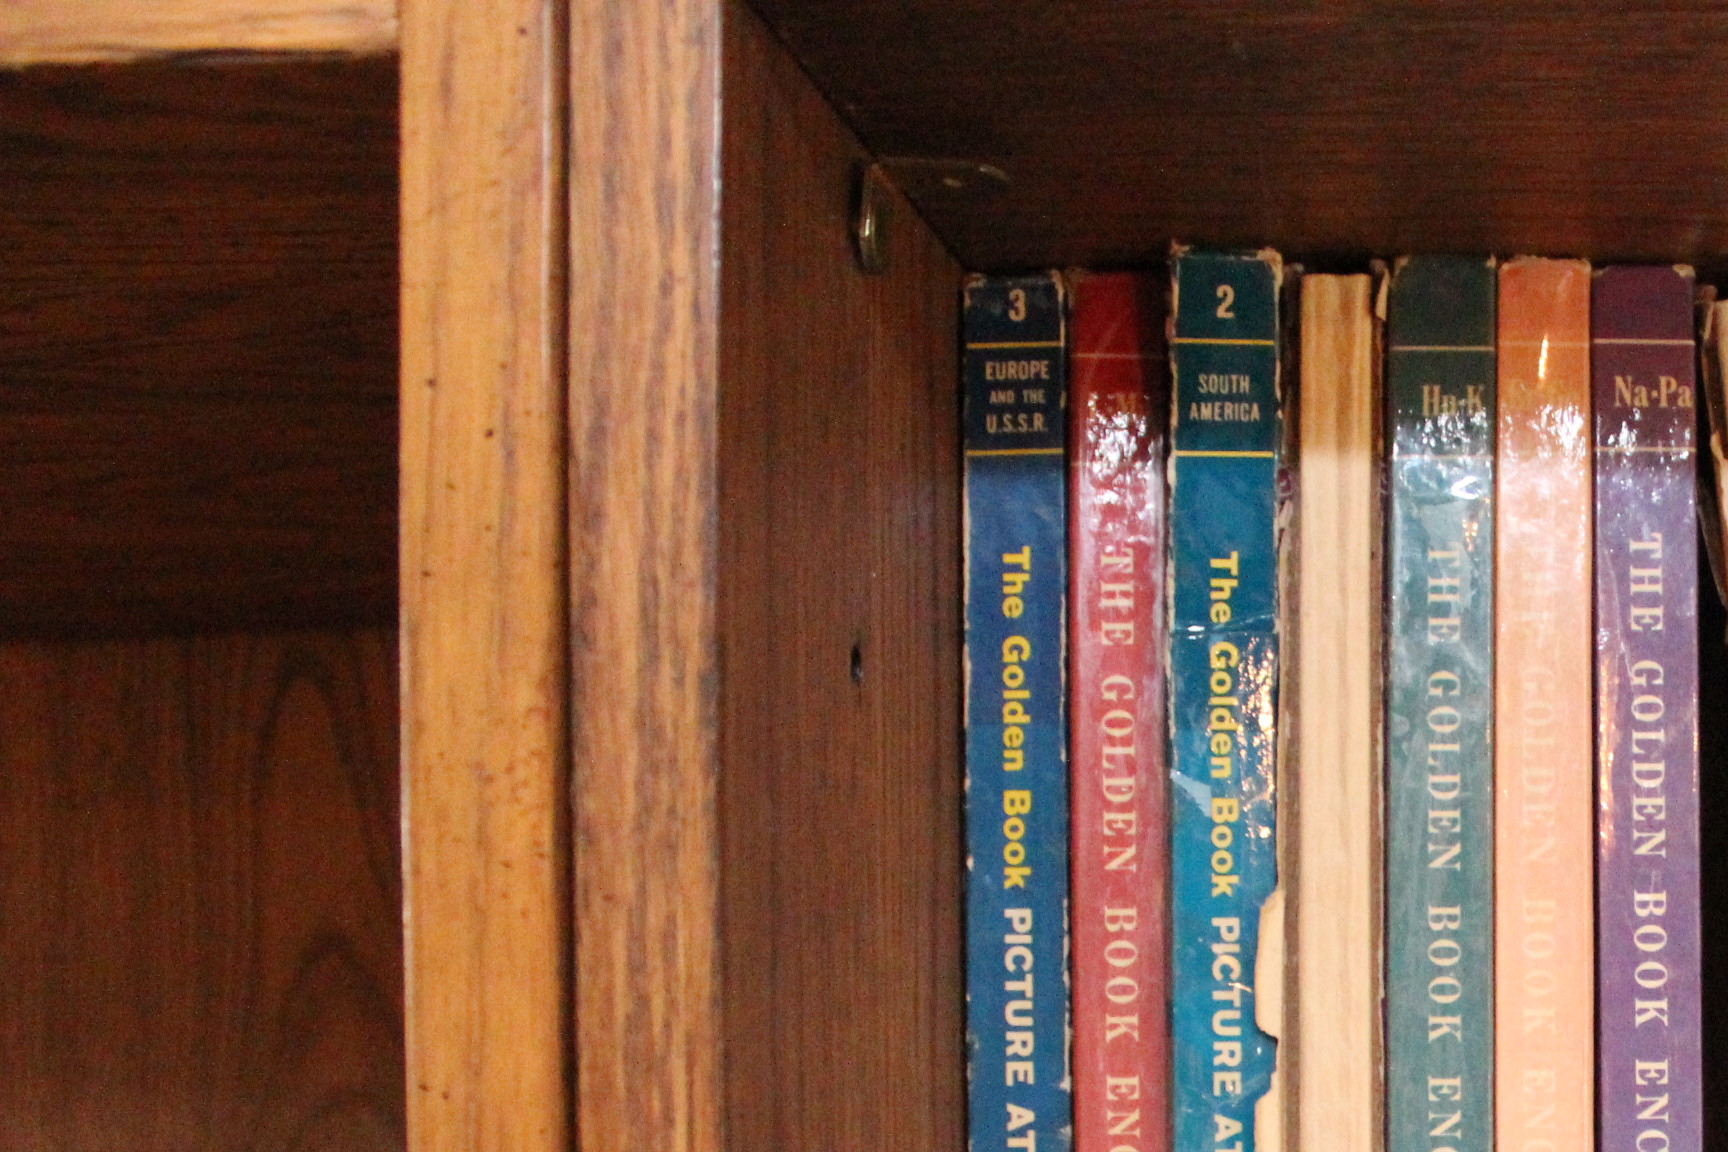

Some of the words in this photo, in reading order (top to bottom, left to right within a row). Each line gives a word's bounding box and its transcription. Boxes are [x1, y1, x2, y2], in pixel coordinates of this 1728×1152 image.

[1008, 289, 1026, 321] 3
[1216, 284, 1235, 319] 2
[985, 360, 1049, 380] EUROPE
[989, 390, 1015, 404] AND
[1023, 389, 1046, 404] THE
[1189, 402, 1260, 422] AMERICA
[1198, 374, 1250, 395] SOUTH
[1002, 546, 1031, 619] The
[1101, 546, 1134, 645] THE
[1208, 551, 1239, 624] The
[1427, 548, 1461, 644] THE
[1629, 532, 1664, 633] THE
[1002, 636, 1031, 772] Golden
[1208, 640, 1239, 779] Golden
[1100, 674, 1137, 874] GOLDEN
[1427, 670, 1461, 871] GOLDEN
[1629, 660, 1667, 859] GOLDEN
[1003, 789, 1032, 889] Book
[1211, 797, 1240, 898] Book
[1004, 907, 1034, 1087] PICTURE
[1104, 905, 1139, 1044] BOOK
[1211, 916, 1242, 1097] PICTURE
[1428, 905, 1462, 1043] BOOK
[1522, 898, 1557, 1034] BOOK
[1633, 890, 1669, 1029] BOOK
